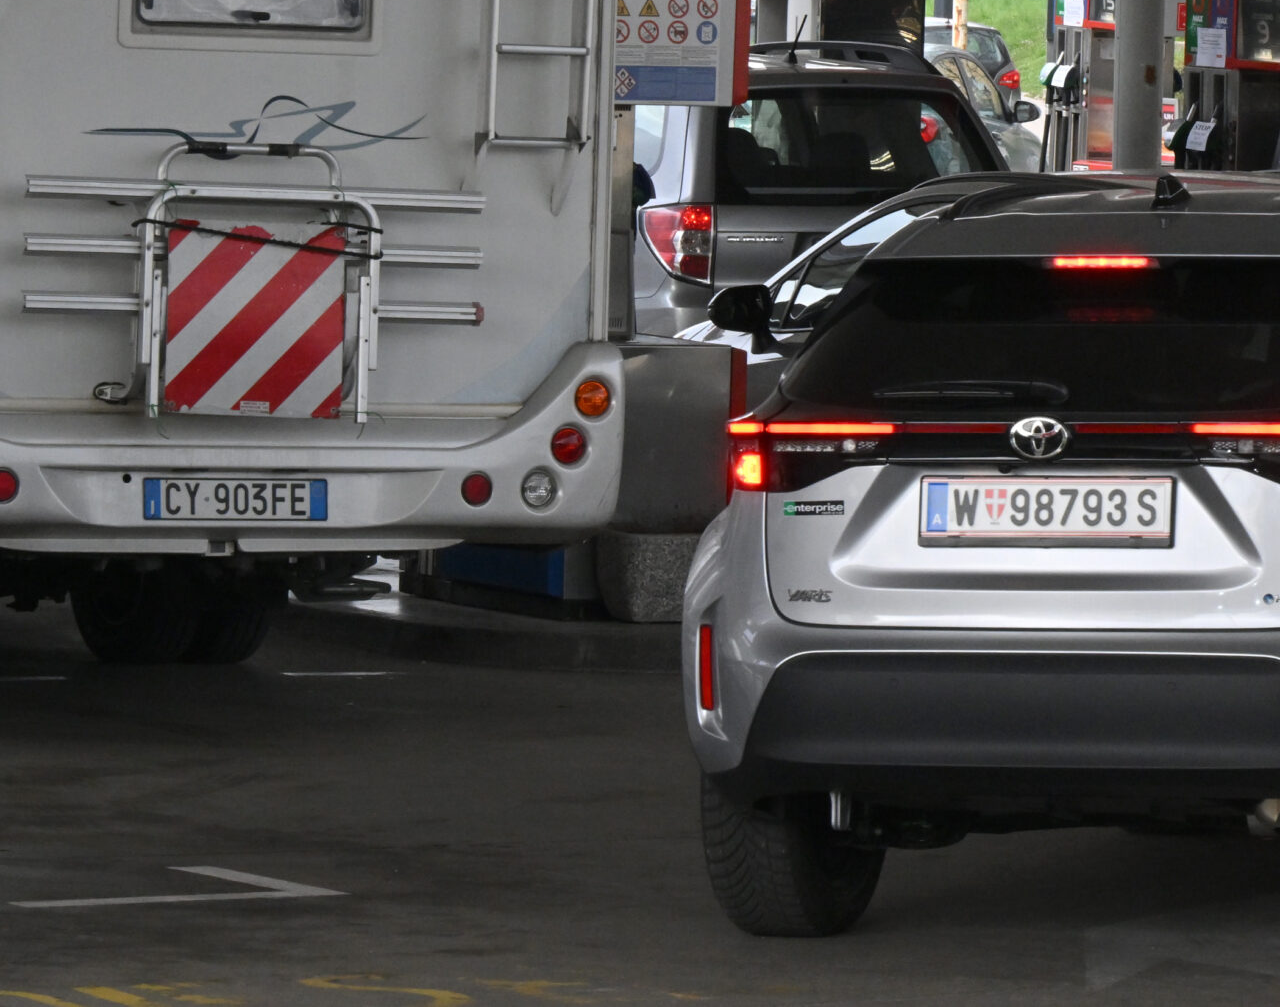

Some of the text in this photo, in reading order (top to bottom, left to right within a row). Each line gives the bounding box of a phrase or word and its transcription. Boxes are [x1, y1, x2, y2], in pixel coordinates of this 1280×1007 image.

[165, 482, 200, 516] CY
[214, 483, 307, 516] 903FE
[785, 502, 844, 514] enterprise
[932, 488, 1158, 527] A W 98793 S
